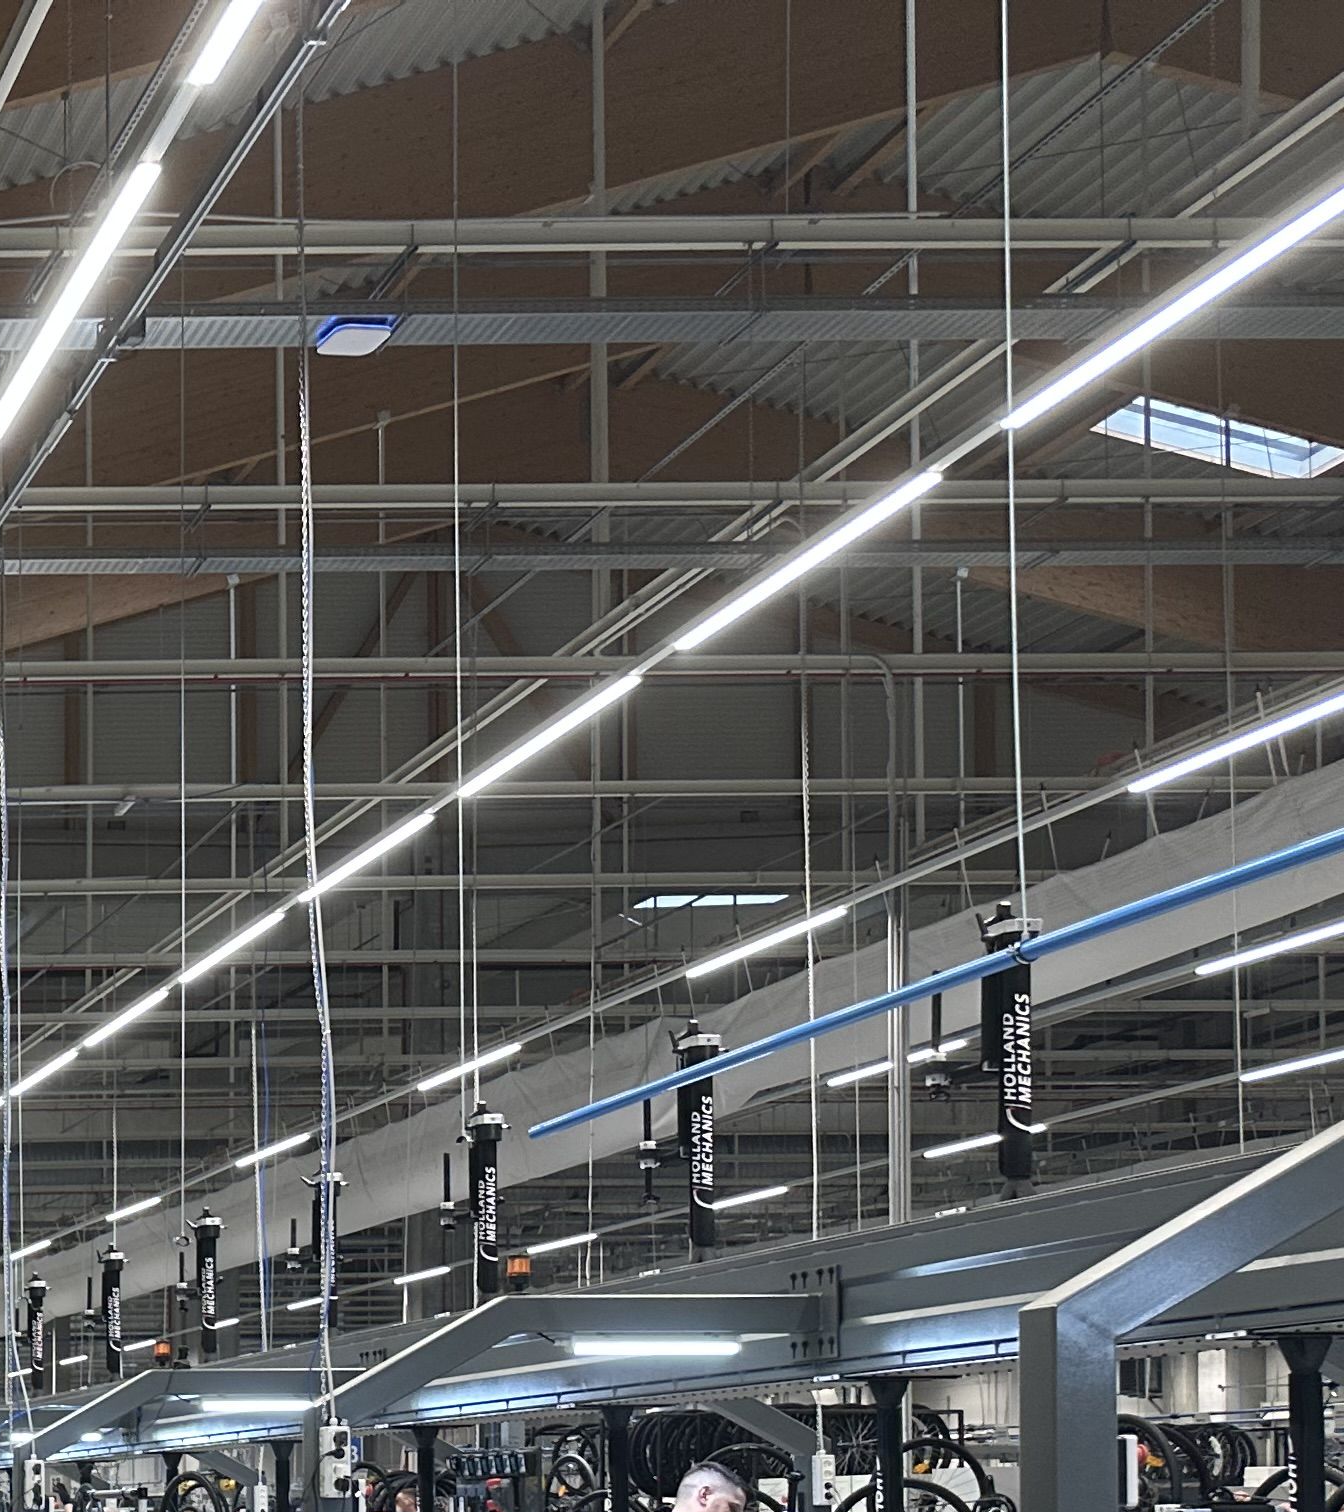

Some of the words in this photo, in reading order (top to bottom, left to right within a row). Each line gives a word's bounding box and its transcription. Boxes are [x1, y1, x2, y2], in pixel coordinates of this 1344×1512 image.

[1003, 1013, 1017, 1100] HOLLAND
[1014, 993, 1032, 1103] MECHANICS
[691, 1111, 701, 1184] HOLLAND
[701, 1095, 714, 1186] MECHANICS
[478, 1179, 486, 1240] HOLLAND
[485, 1166, 497, 1242] MECHANICS
[205, 1257, 216, 1315] MECHANICS
